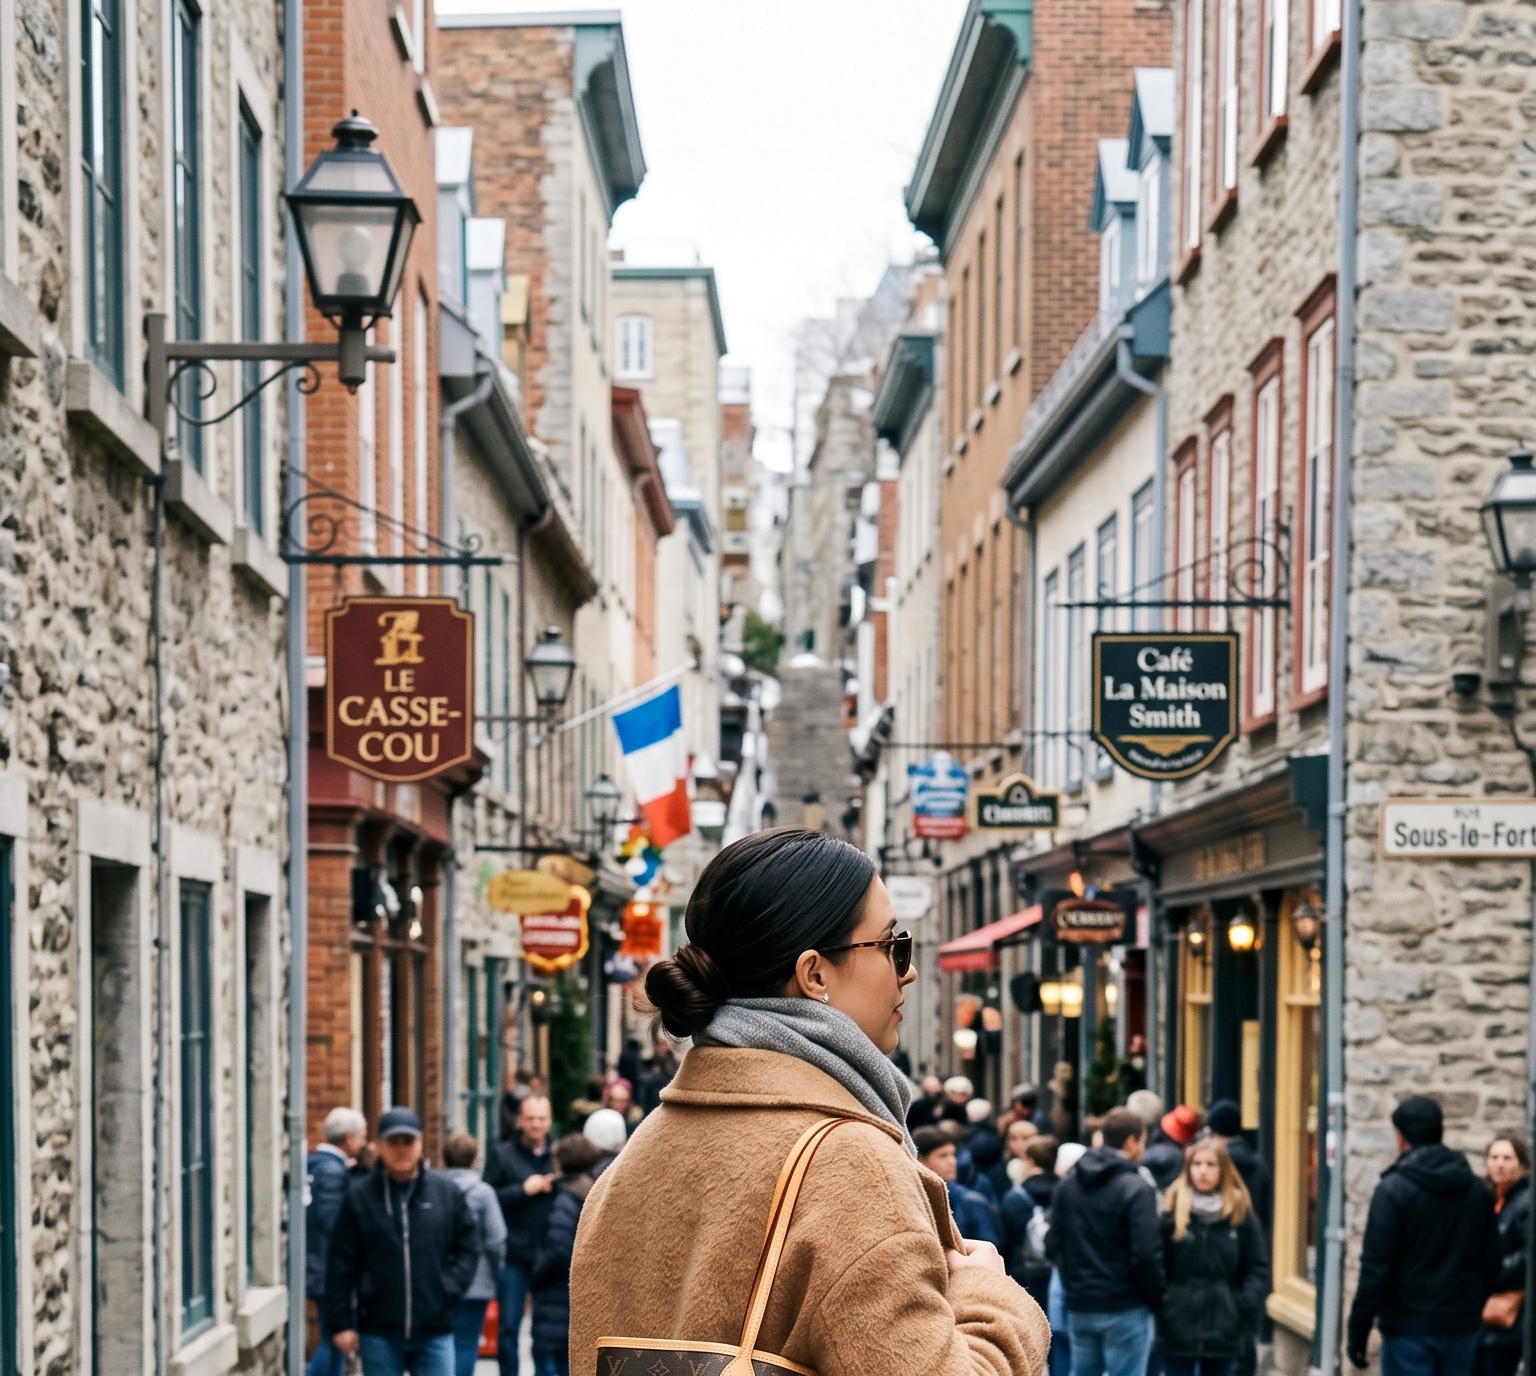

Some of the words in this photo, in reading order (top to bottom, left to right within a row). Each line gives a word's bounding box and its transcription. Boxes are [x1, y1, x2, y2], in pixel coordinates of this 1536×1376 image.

[1137, 646, 1193, 672] Café
[384, 669, 415, 692] LE
[1104, 675, 1135, 700] La
[1140, 675, 1227, 700] Maison
[338, 695, 462, 727] CASSE-
[1129, 702, 1201, 728] Smith
[358, 731, 440, 763] COU
